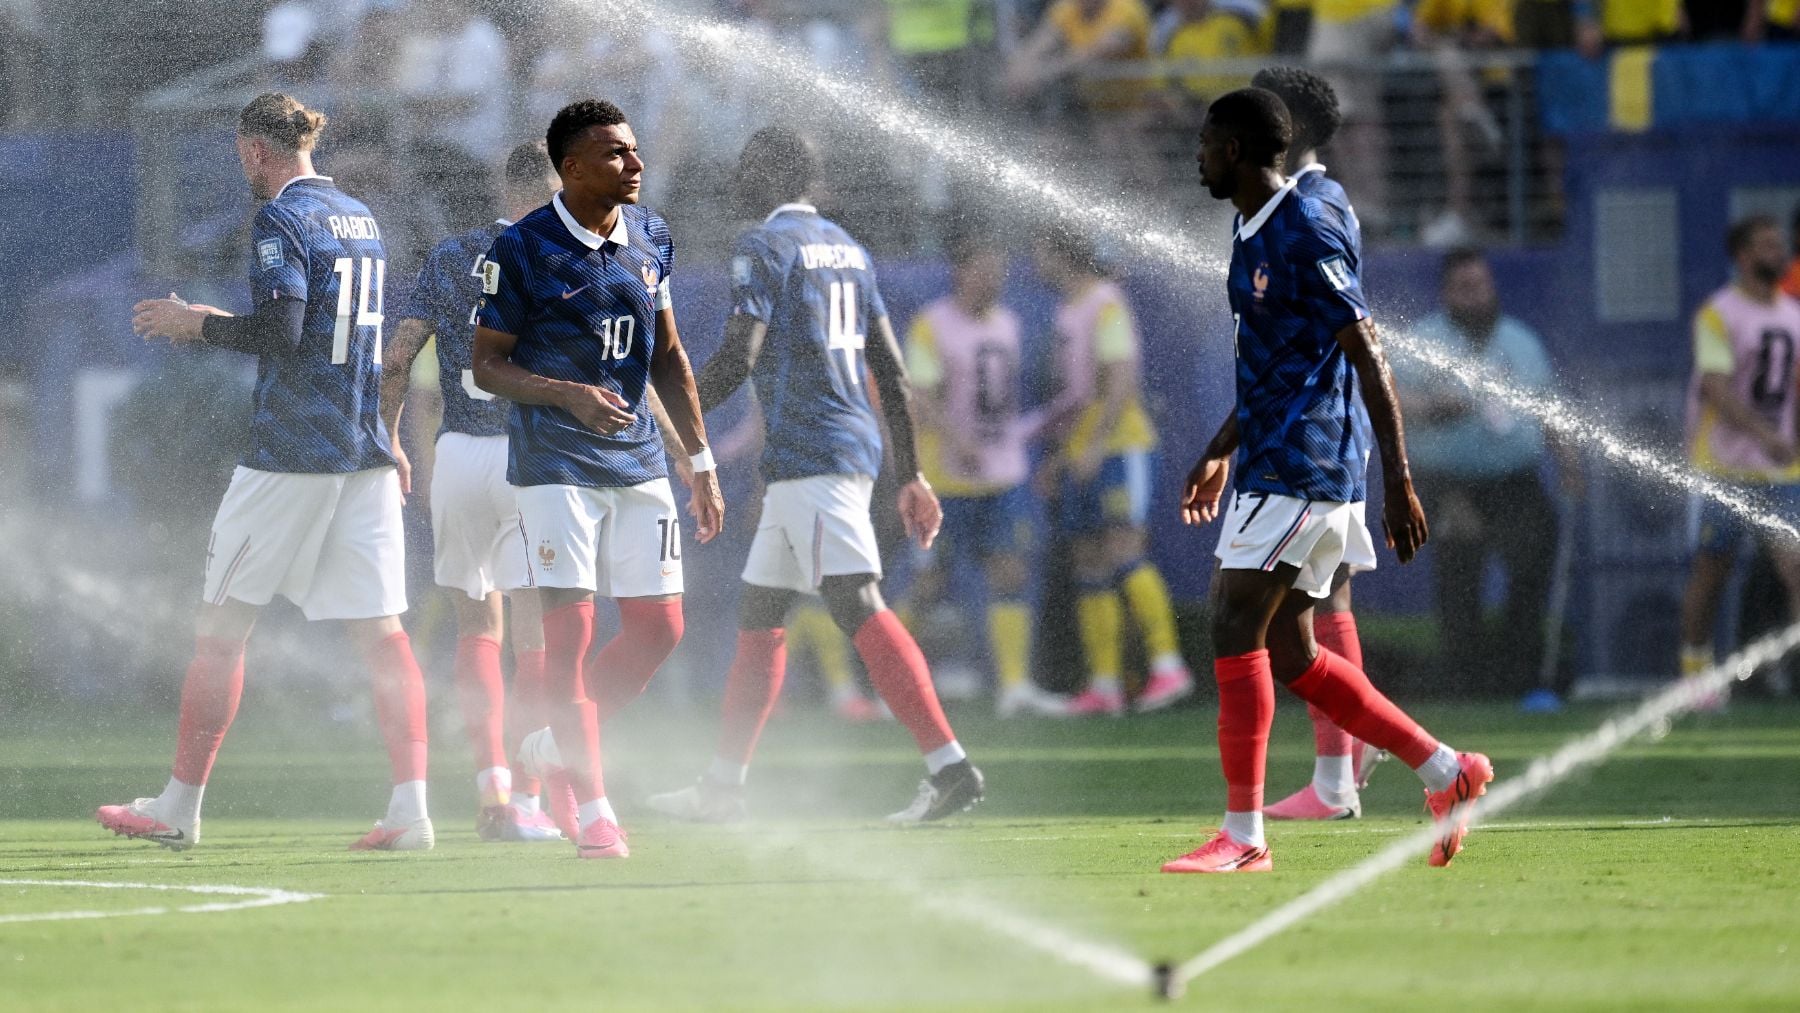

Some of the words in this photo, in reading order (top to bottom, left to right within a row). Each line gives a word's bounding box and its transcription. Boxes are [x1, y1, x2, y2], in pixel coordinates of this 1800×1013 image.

[331, 257, 384, 364] 14
[828, 281, 865, 385] 4
[601, 315, 635, 361] 10
[1238, 492, 1269, 534] 7
[657, 518, 680, 561] 10
